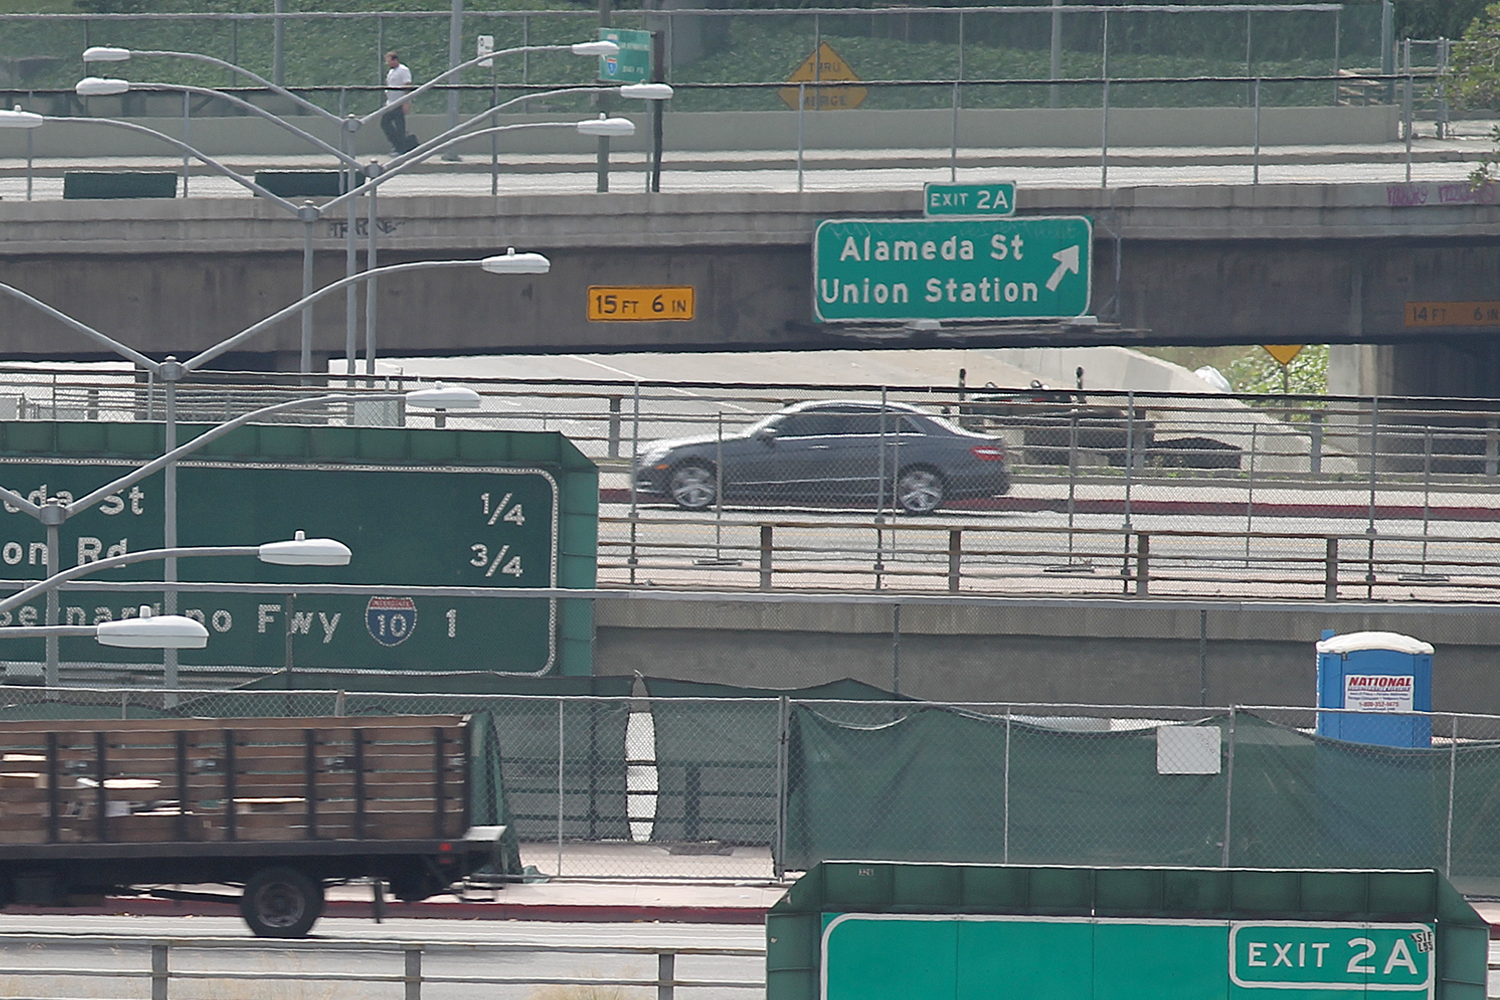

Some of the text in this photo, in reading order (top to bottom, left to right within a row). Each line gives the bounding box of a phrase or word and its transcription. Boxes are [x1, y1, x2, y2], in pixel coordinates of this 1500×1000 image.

[930, 190, 1009, 209] EXIT 2A
[840, 234, 1024, 261] Alameda St
[596, 294, 686, 314] 15 FT 6 IN
[820, 277, 1038, 304] Union Station
[1413, 307, 1427, 321] 14
[1432, 308, 1446, 321] FT
[1473, 307, 1483, 321] 6
[99, 485, 145, 515] St
[77, 537, 128, 568] Rd
[257, 603, 341, 643] Fwy
[377, 614, 406, 637] 10
[446, 609, 457, 637] 1
[1349, 677, 1411, 686] NATIONAL
[1248, 938, 1418, 975] EXIT 2A
